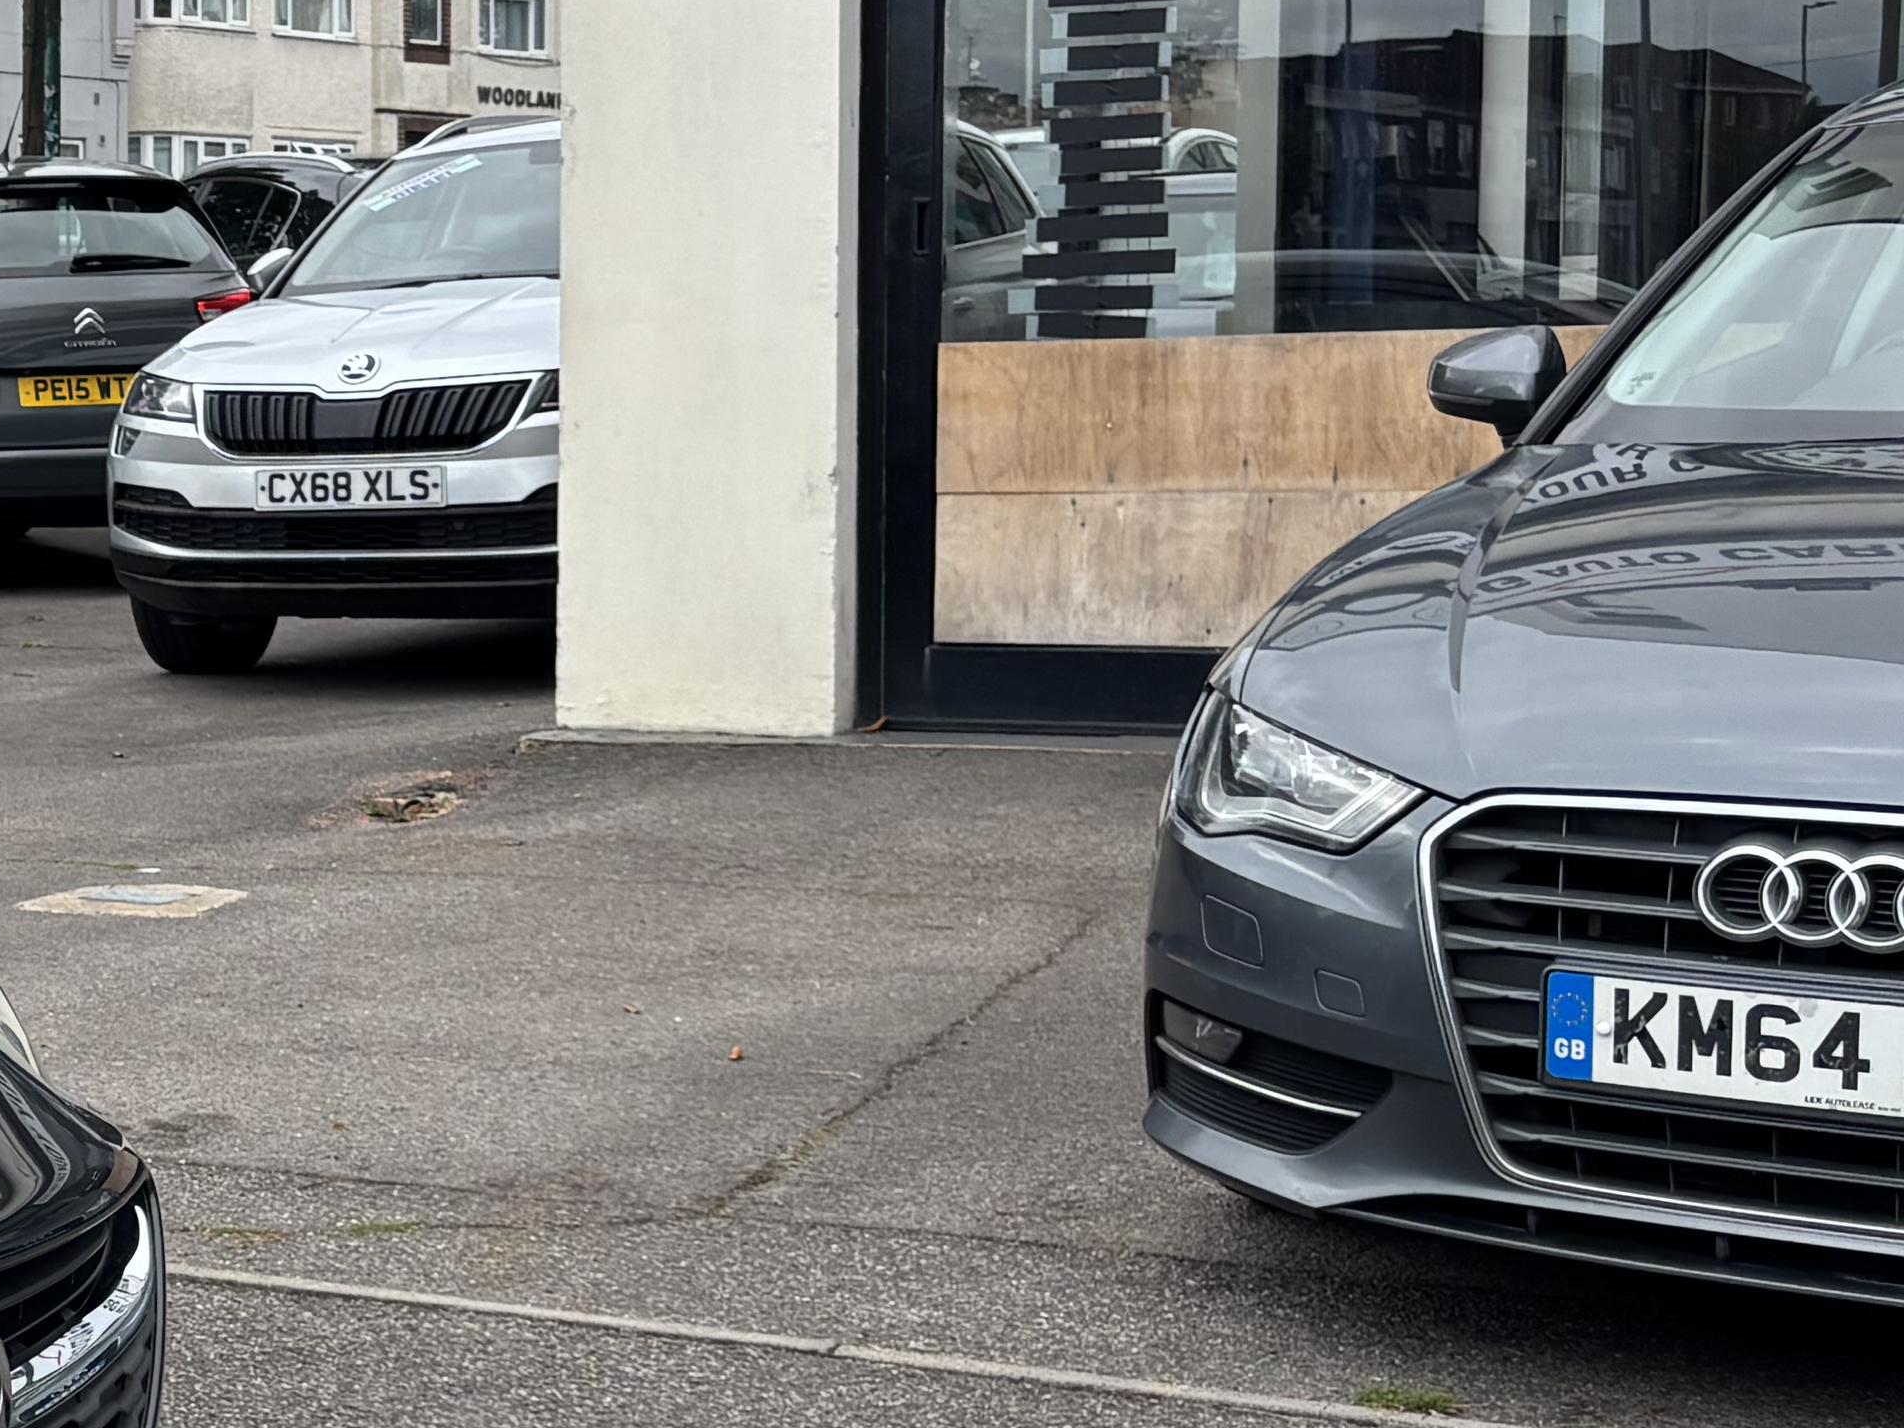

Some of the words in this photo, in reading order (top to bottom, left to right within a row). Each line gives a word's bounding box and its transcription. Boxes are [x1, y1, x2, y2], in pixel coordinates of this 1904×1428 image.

[33, 377, 91, 402] PE15
[268, 471, 352, 504] CX68
[363, 469, 430, 502] XLS
[1554, 1037, 1586, 1060] GB
[1612, 987, 1871, 1091] KM64
[1824, 1098, 1875, 1110] AUTOLEASE
